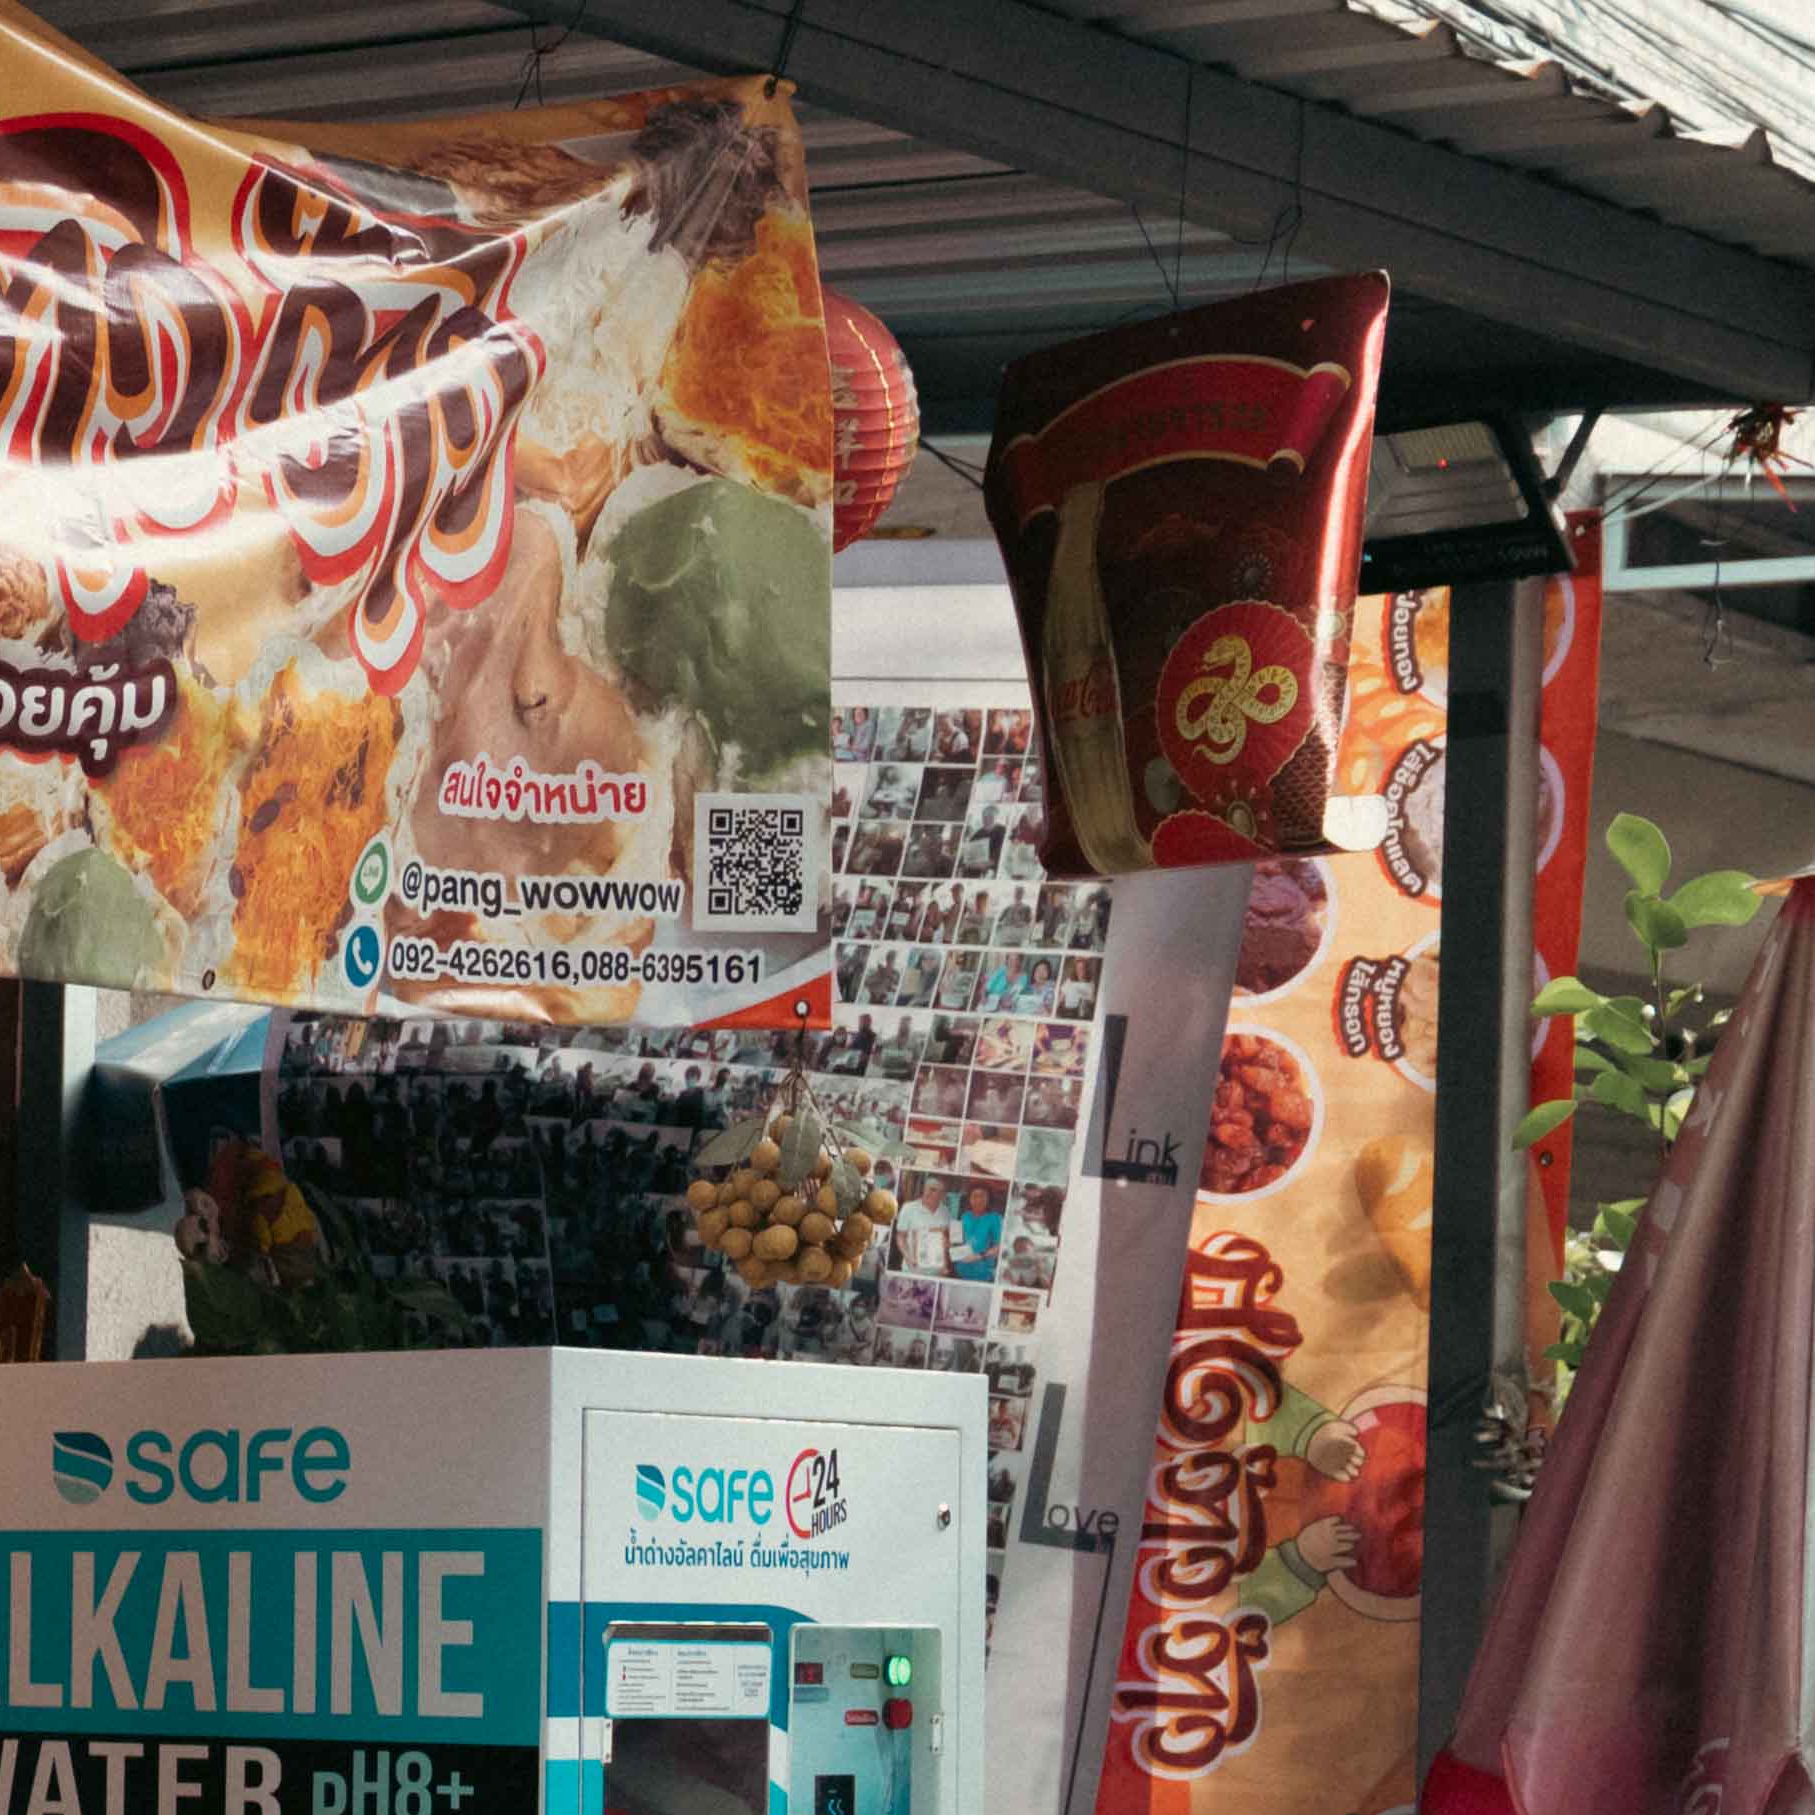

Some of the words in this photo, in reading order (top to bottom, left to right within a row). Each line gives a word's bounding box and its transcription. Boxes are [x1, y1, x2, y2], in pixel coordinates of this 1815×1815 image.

[442, 759, 647, 817] สนใจจำหน่าย
[402, 862, 683, 918] @pang_wowwow
[391, 943, 761, 987] 092-4262616,088-6395161
[126, 1426, 350, 1504] safe
[812, 1448, 840, 1510] 24
[671, 1465, 774, 1525] safe
[811, 1498, 848, 1538] HOURS
[625, 1528, 744, 1568] น้ำด่างอัลคาไลน์
[750, 1533, 850, 1577] ดื่มเพื่อสุขภาพ
